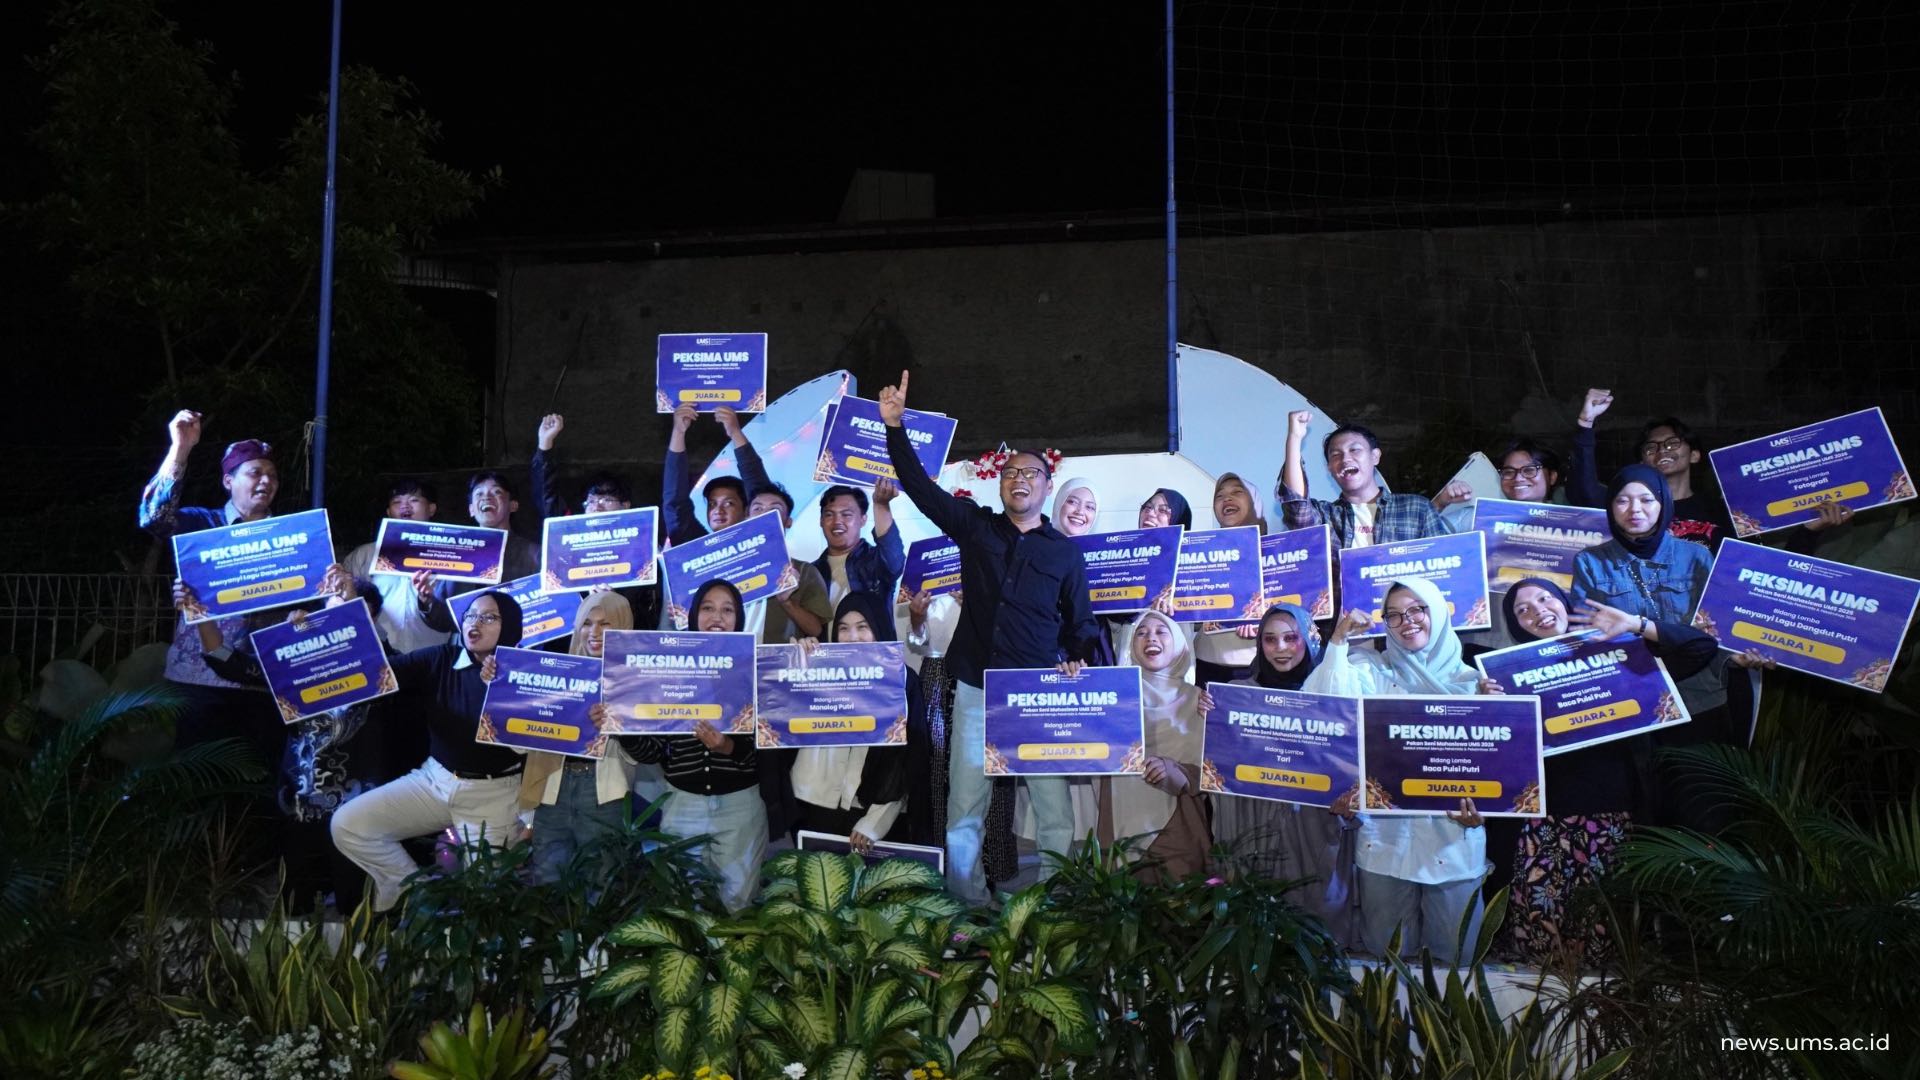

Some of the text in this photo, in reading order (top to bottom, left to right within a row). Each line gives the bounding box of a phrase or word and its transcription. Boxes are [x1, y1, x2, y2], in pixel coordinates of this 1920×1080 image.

[673, 352, 749, 362] PEKSIMA UMS
[850, 416, 887, 433] PEKSI
[1770, 437, 1789, 448] UMS
[1741, 450, 1818, 476] PEKSIMA
[1820, 436, 1863, 455] UMS
[864, 463, 889, 474] JUARA
[1794, 477, 1828, 490] Fotografi
[1793, 493, 1832, 508] JUARA
[613, 527, 639, 537] UMS
[1494, 522, 1563, 542] PEKSIMA
[1567, 529, 1602, 544] UMS
[401, 532, 455, 544] PEKSIMA
[459, 538, 485, 547] UMS
[200, 540, 271, 563] PEKSIMA
[273, 533, 307, 548] UMS
[683, 545, 737, 573] PEKSIMA
[738, 534, 766, 551] UMS
[921, 545, 960, 560] PEKSI
[1133, 546, 1161, 558] UMS
[1208, 550, 1240, 563] UMS
[1279, 549, 1308, 564] UMS
[1361, 556, 1462, 578] PEKSIMA UMS
[1788, 559, 1810, 571] UMS
[241, 584, 275, 596] JUARA
[1738, 568, 1826, 602] PEKSIMA
[1830, 590, 1879, 614] UMS
[1773, 608, 1820, 624] Bidang Lomba
[1734, 605, 1775, 622] Menyanyi
[1774, 614, 1796, 628] Lagu
[1797, 622, 1835, 637] Dangdut
[1835, 632, 1858, 643] Putri
[276, 636, 329, 660] PEKSIMA
[328, 626, 357, 644] UMS
[660, 637, 677, 645] UMS
[1760, 631, 1814, 653] JUARA 1
[1538, 645, 1558, 656] UMS
[541, 657, 555, 665] UMS
[626, 655, 733, 669] PEKSIMA UMS
[778, 666, 884, 682] PEKSIMA UMS
[1513, 658, 1589, 687] PEKSIMA
[1589, 649, 1628, 670] UMS
[508, 671, 598, 693] PEKSIMA UMS
[1041, 674, 1058, 682] UMS
[319, 682, 343, 695] JUARA
[664, 691, 694, 699] Fotografi
[1007, 692, 1118, 707] PEKSIMA UMS
[1265, 695, 1283, 704] UMS
[1557, 690, 1612, 709] Baca Puisi Putri
[810, 704, 837, 712] Monolog
[1425, 705, 1445, 713] UMS
[1228, 711, 1345, 736] PEKSIMA UMS
[1568, 708, 1616, 726] JUARA 2
[526, 724, 554, 735] JUARA
[812, 721, 846, 729] JUARA
[1389, 725, 1511, 740] PEKSIMA UMS
[1041, 747, 1086, 756] JUARA 3
[1277, 755, 1291, 763] Tari
[1261, 772, 1297, 783] JUARA
[1428, 784, 1466, 792] JUARA
